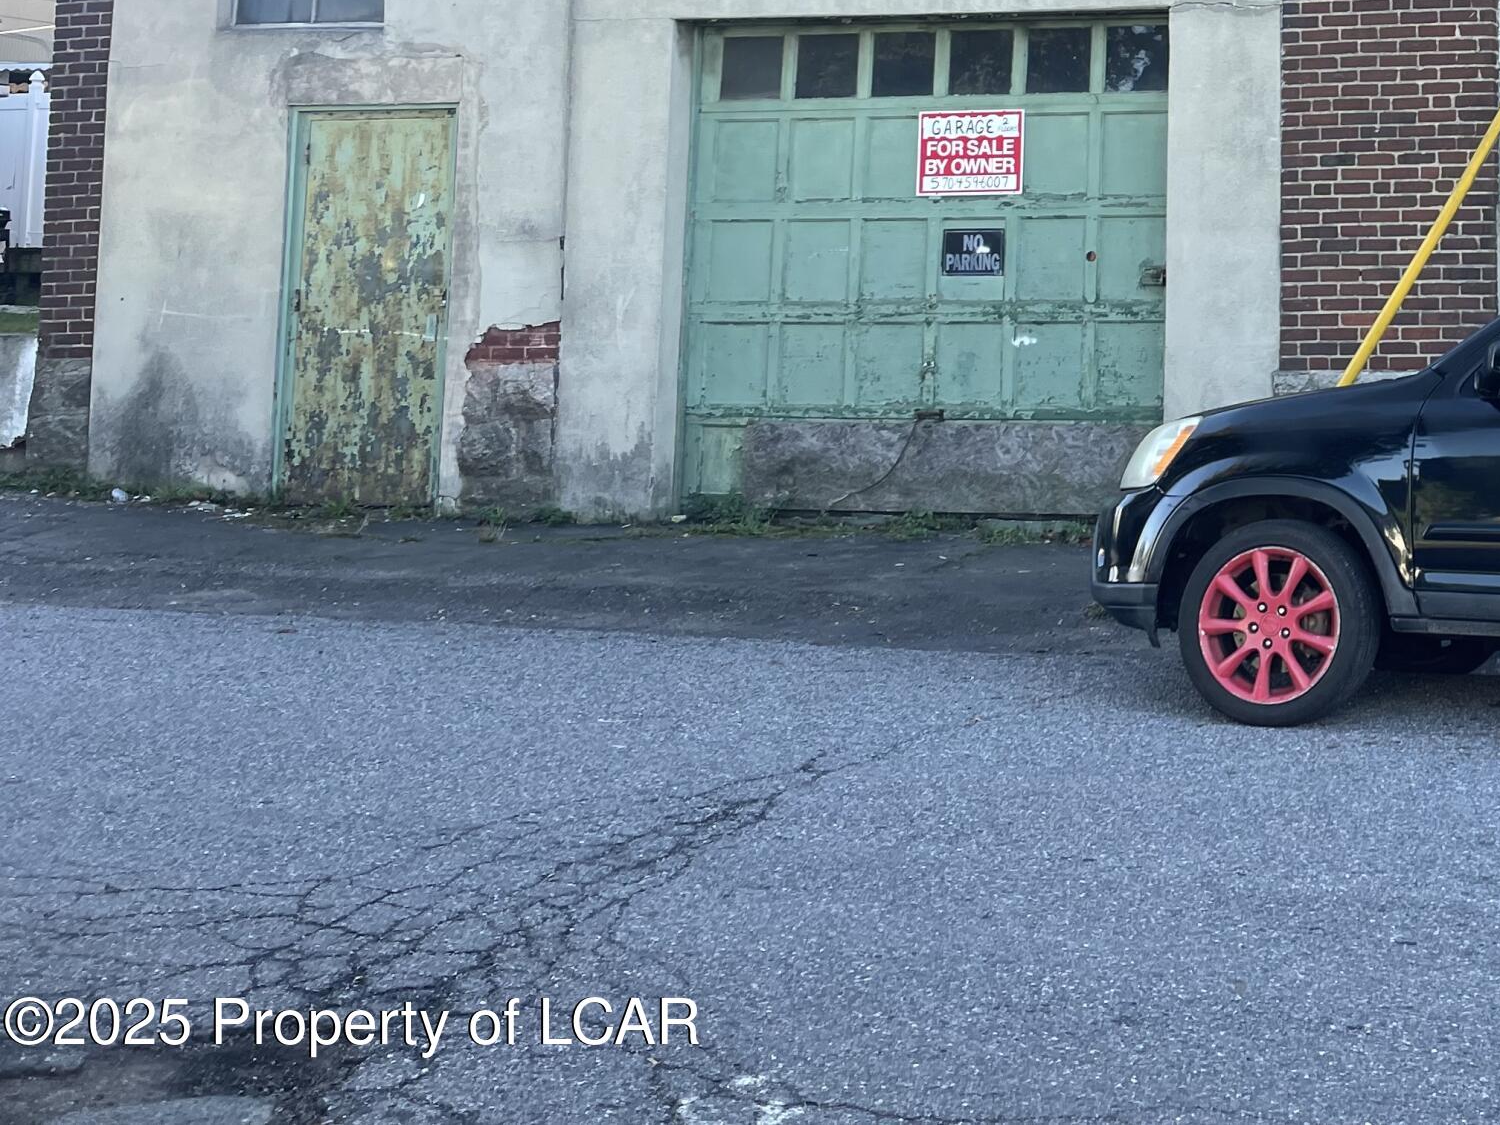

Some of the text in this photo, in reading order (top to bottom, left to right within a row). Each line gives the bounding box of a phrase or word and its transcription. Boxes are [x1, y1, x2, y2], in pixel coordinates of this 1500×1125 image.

[932, 117, 1009, 135] GARAGE 2
[926, 139, 1015, 156] FOR SALE
[924, 157, 1016, 175] BY OWNER
[963, 234, 984, 252] NO
[946, 253, 1000, 271] PARKING
